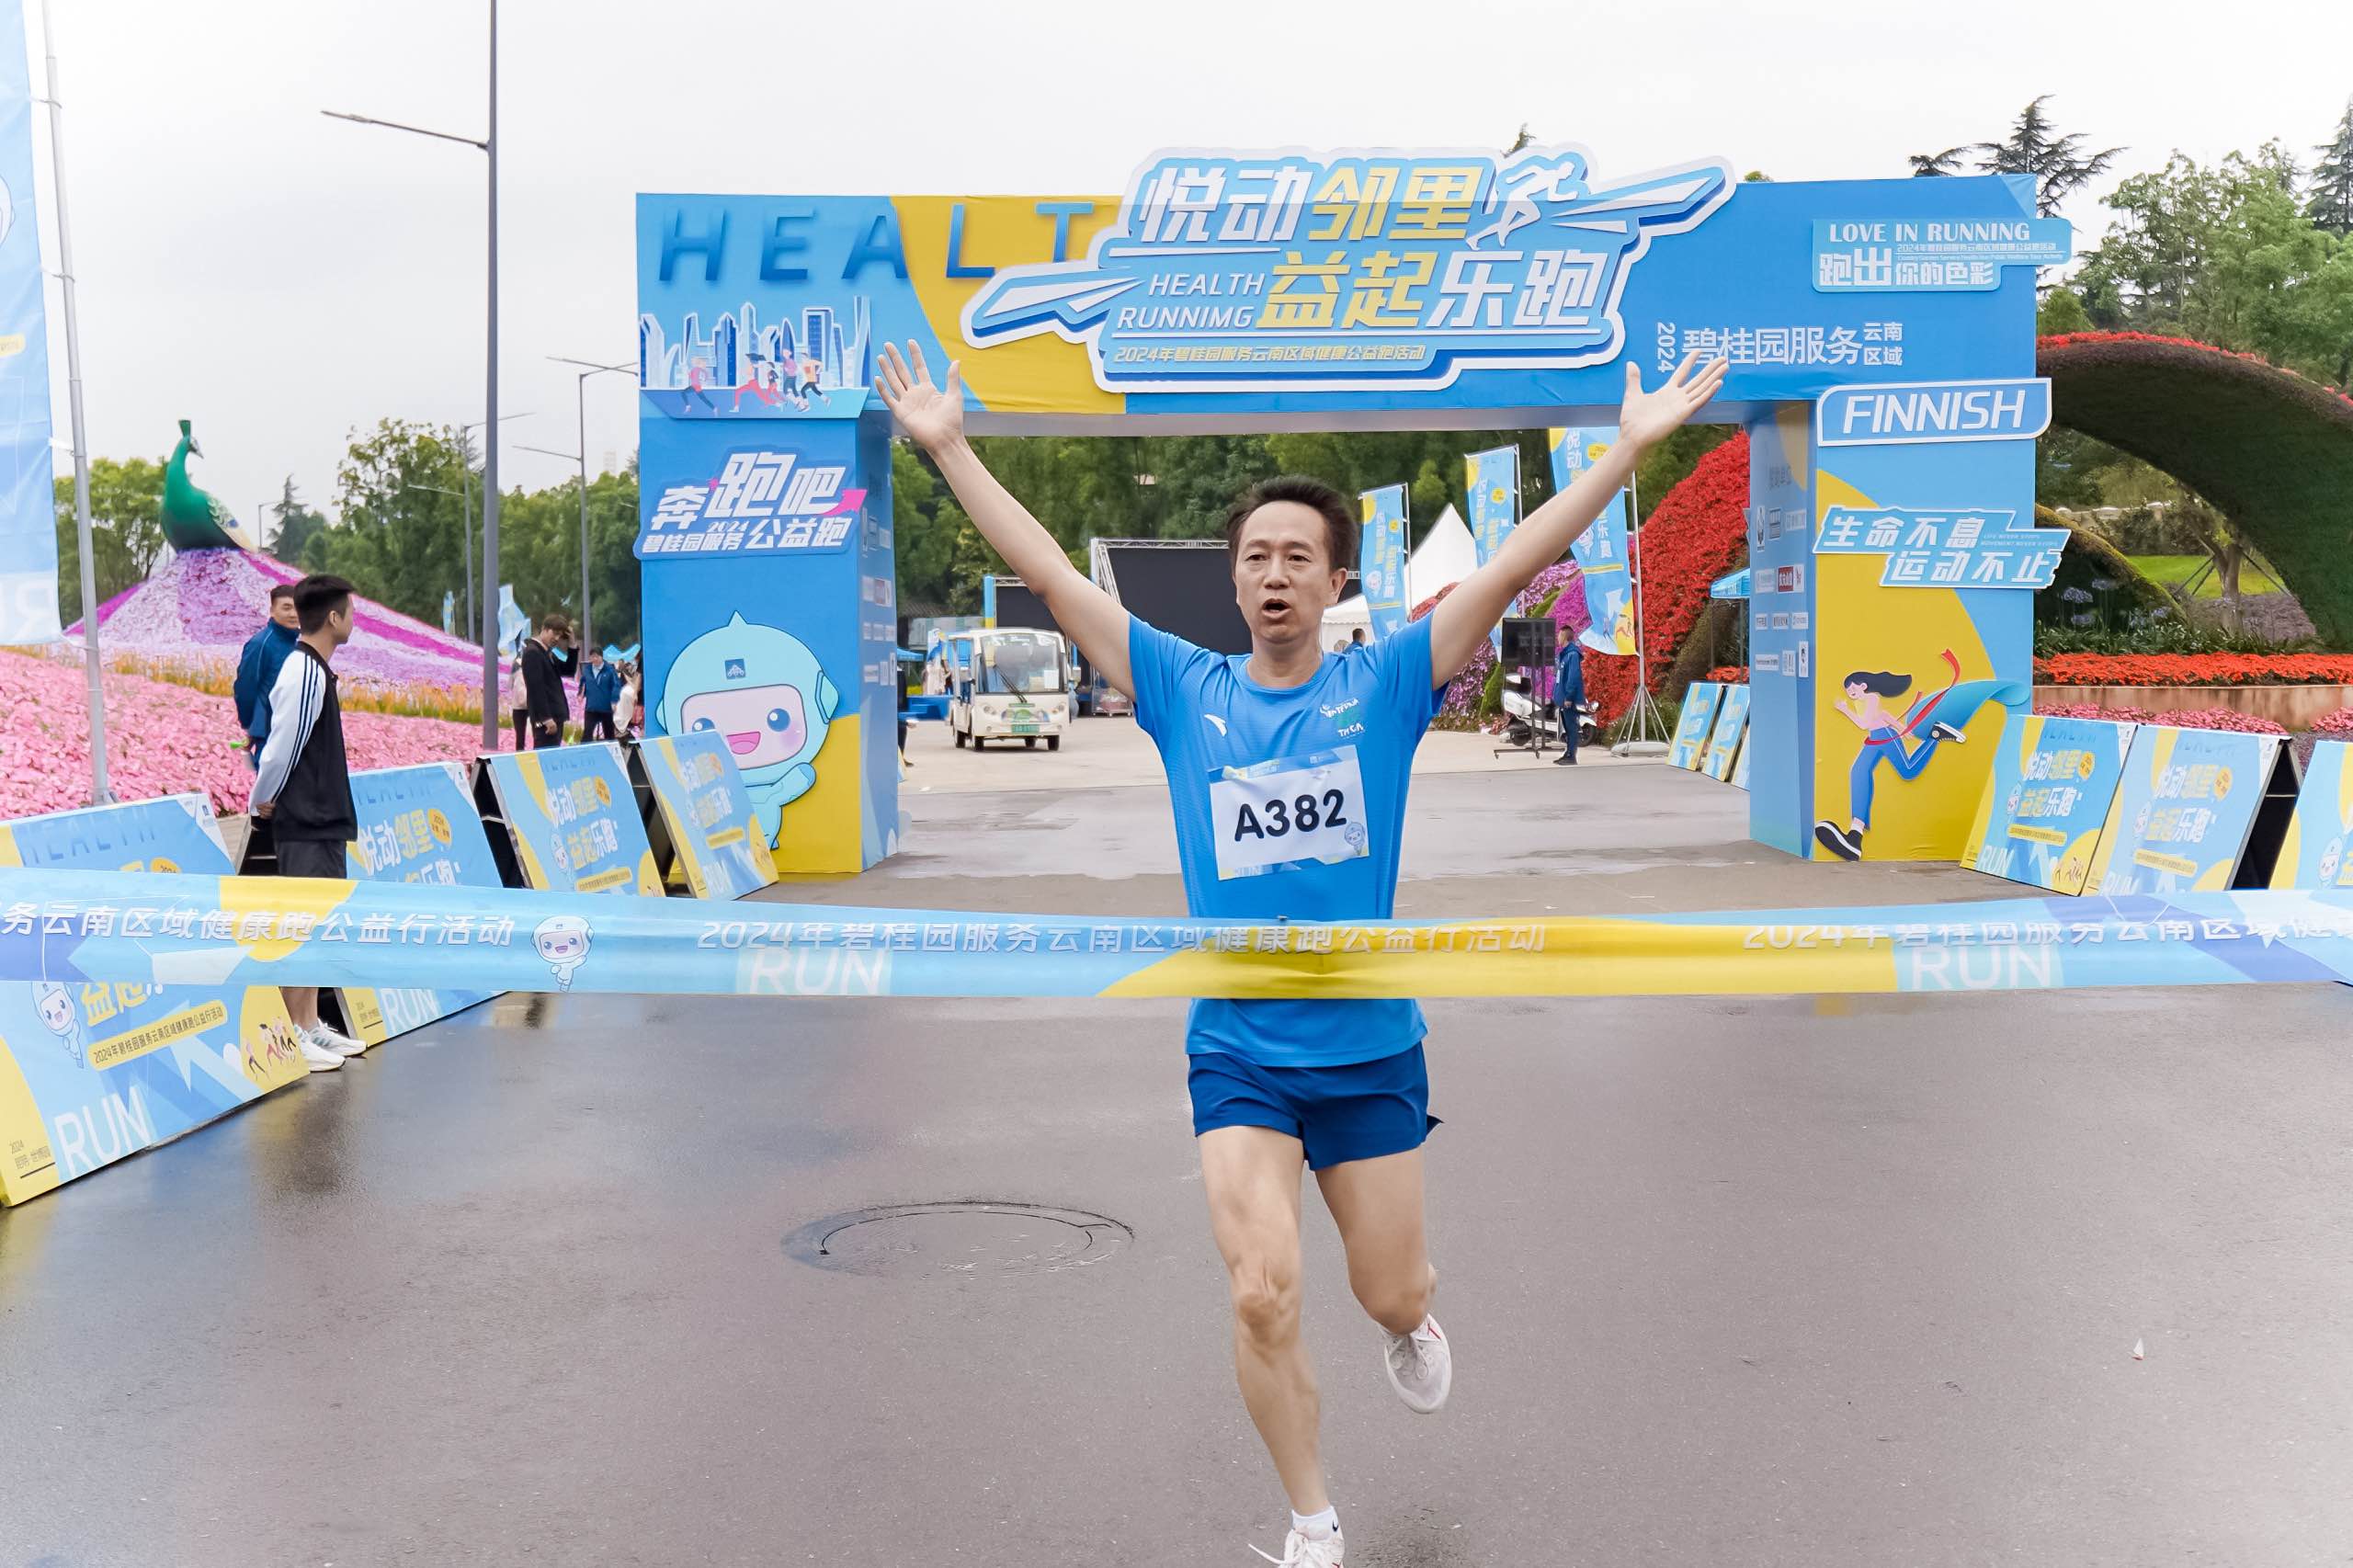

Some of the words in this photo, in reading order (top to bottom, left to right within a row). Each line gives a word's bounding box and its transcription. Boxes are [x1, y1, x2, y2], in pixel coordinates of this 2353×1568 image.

[1140, 165, 1486, 243] 悦动邻里
[1829, 222, 1887, 243] LOVE
[1895, 222, 1918, 243] IN
[1927, 222, 2030, 242] RUNNING
[1148, 272, 1266, 296] HEALTH
[1820, 246, 1893, 287] 跑出
[1896, 261, 1994, 286] 你的色彩
[1256, 248, 1608, 329] 益起乐跑
[1117, 305, 1255, 330] RUNNIMG
[1864, 322, 1903, 342] 云南
[1657, 322, 1676, 373] 2024
[1682, 325, 1863, 367] 碧桂园服务
[1864, 347, 1903, 367] 区域
[1843, 390, 2026, 434] FINNISH
[651, 452, 847, 531] 奔跑吧
[642, 532, 745, 553] 碧桂园服务
[708, 520, 749, 533] 2024
[745, 517, 853, 550] 公益跑
[1824, 516, 1986, 548] 生命不息
[1890, 551, 2052, 582] 运动不止
[1233, 789, 1347, 842] A382
[0, 900, 516, 947] 务云南区域健康跑公益行活动
[748, 947, 884, 995] RUN
[1911, 941, 2052, 990] RUN
[53, 1085, 153, 1179] RUN
